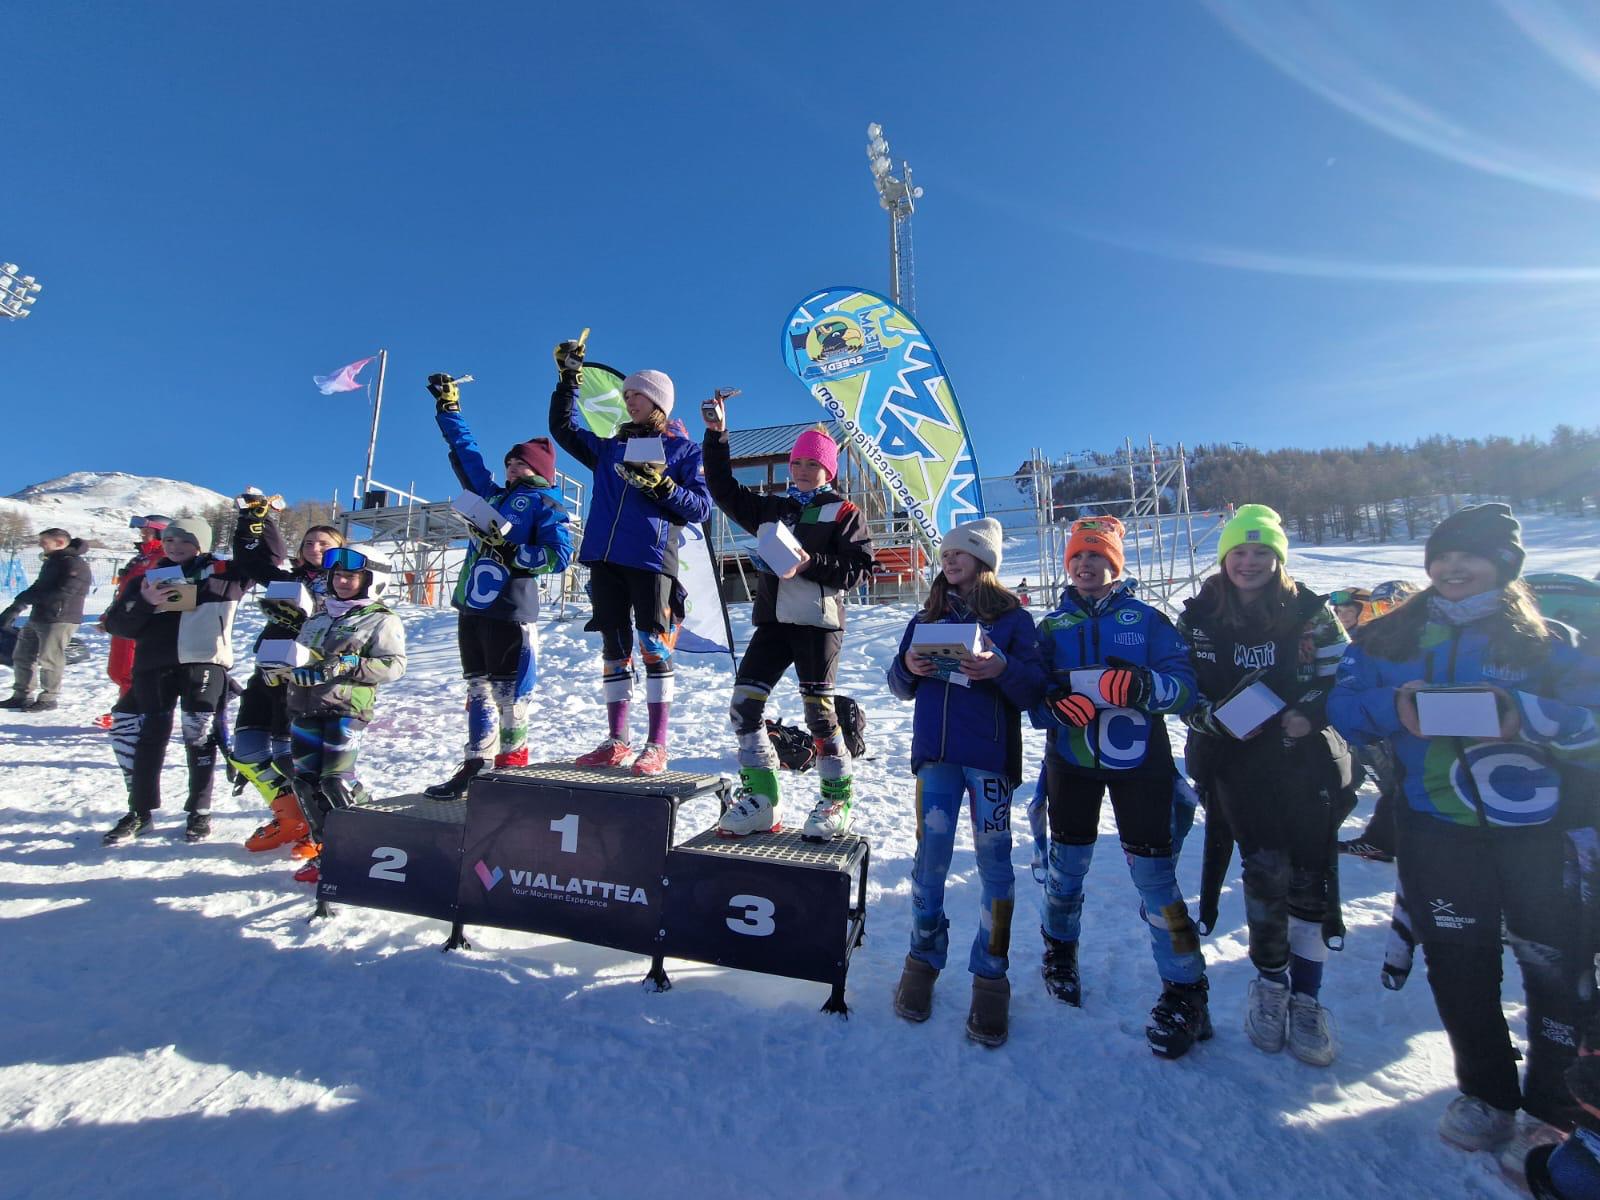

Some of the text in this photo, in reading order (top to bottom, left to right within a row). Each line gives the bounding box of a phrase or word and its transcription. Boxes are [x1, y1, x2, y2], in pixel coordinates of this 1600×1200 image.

[550, 814, 579, 853] 1
[368, 846, 407, 882] 2
[509, 869, 649, 906] VIALATTEA
[512, 887, 608, 908] Your Mountain Experience
[726, 894, 775, 937] 3
